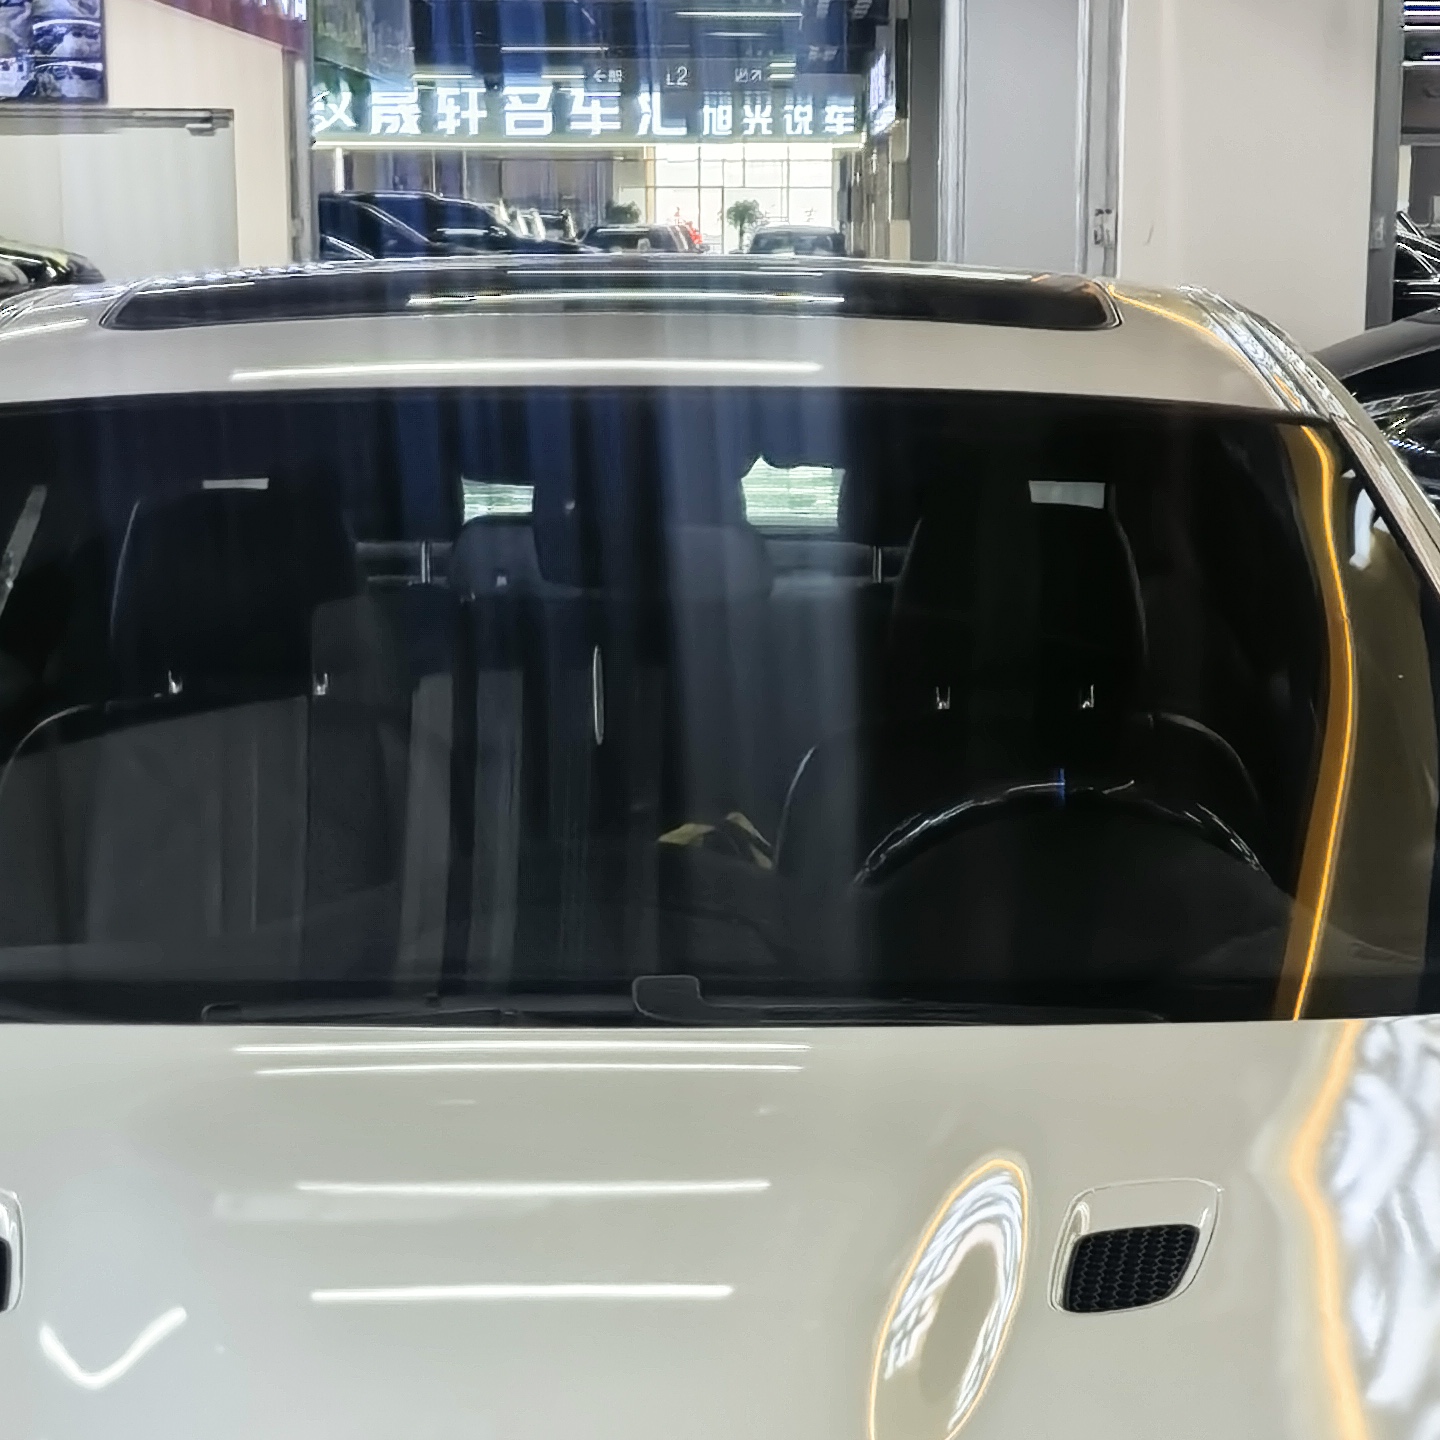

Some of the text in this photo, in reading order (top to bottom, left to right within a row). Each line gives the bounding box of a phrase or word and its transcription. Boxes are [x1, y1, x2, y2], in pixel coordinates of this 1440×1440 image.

[665, 65, 689, 87] L2
[702, 102, 856, 136] 旭光说车
